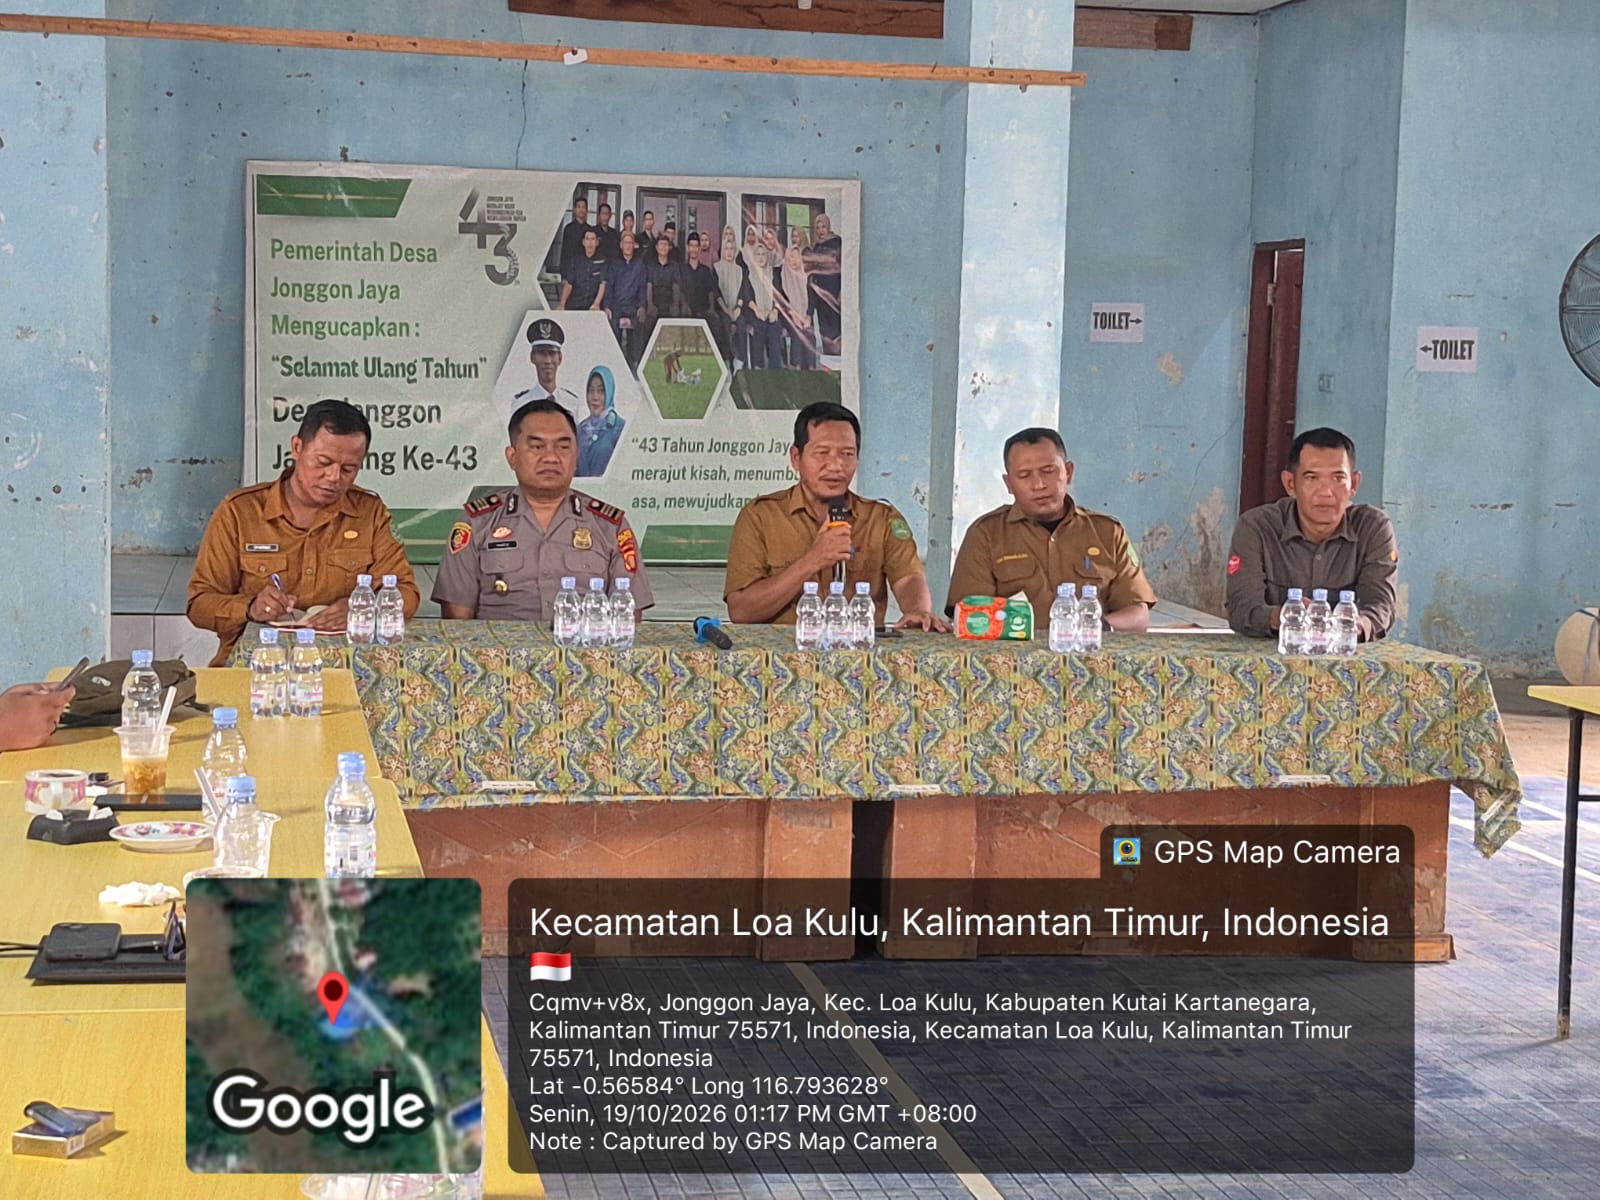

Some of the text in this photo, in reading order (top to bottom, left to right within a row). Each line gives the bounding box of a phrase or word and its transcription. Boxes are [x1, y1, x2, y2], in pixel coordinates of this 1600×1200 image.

[271, 239, 438, 263] Pemerintah Desa
[270, 276, 401, 304] Jonggon Jaya
[1093, 312, 1131, 330] TOILET
[1432, 340, 1475, 360] TOILET
[364, 357, 417, 384] Ulang
[273, 396, 306, 423] De
[272, 444, 297, 470] Ja
[402, 444, 478, 471] Ke-43
[662, 437, 704, 453] Tahun
[707, 438, 765, 456] Jonggon
[768, 438, 791, 456] Jay
[631, 466, 687, 483] merajut
[690, 465, 731, 483] kisah,
[631, 495, 660, 512] asa,
